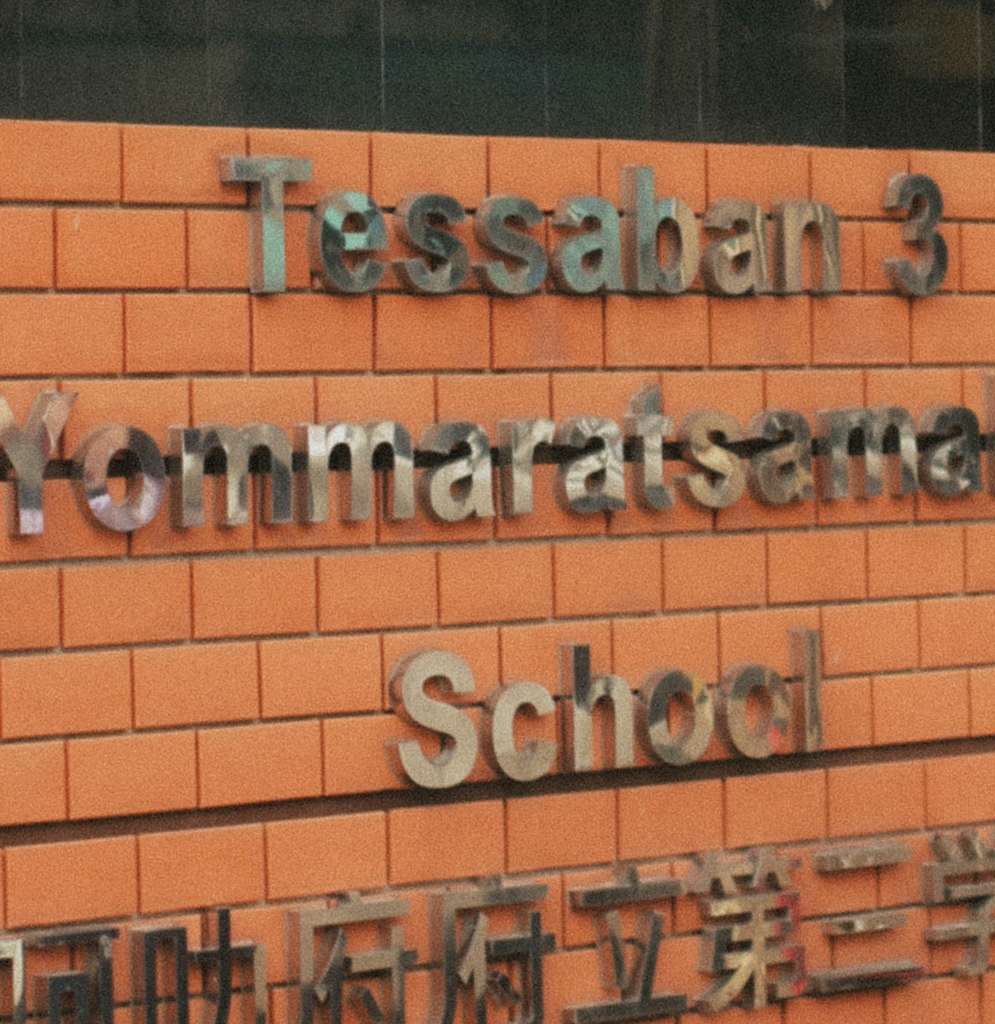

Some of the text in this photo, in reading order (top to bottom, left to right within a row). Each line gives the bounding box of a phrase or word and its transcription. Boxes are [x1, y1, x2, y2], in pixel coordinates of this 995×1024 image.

[219, 154, 949, 298] Tessaban 3
[385, 628, 824, 790] School
